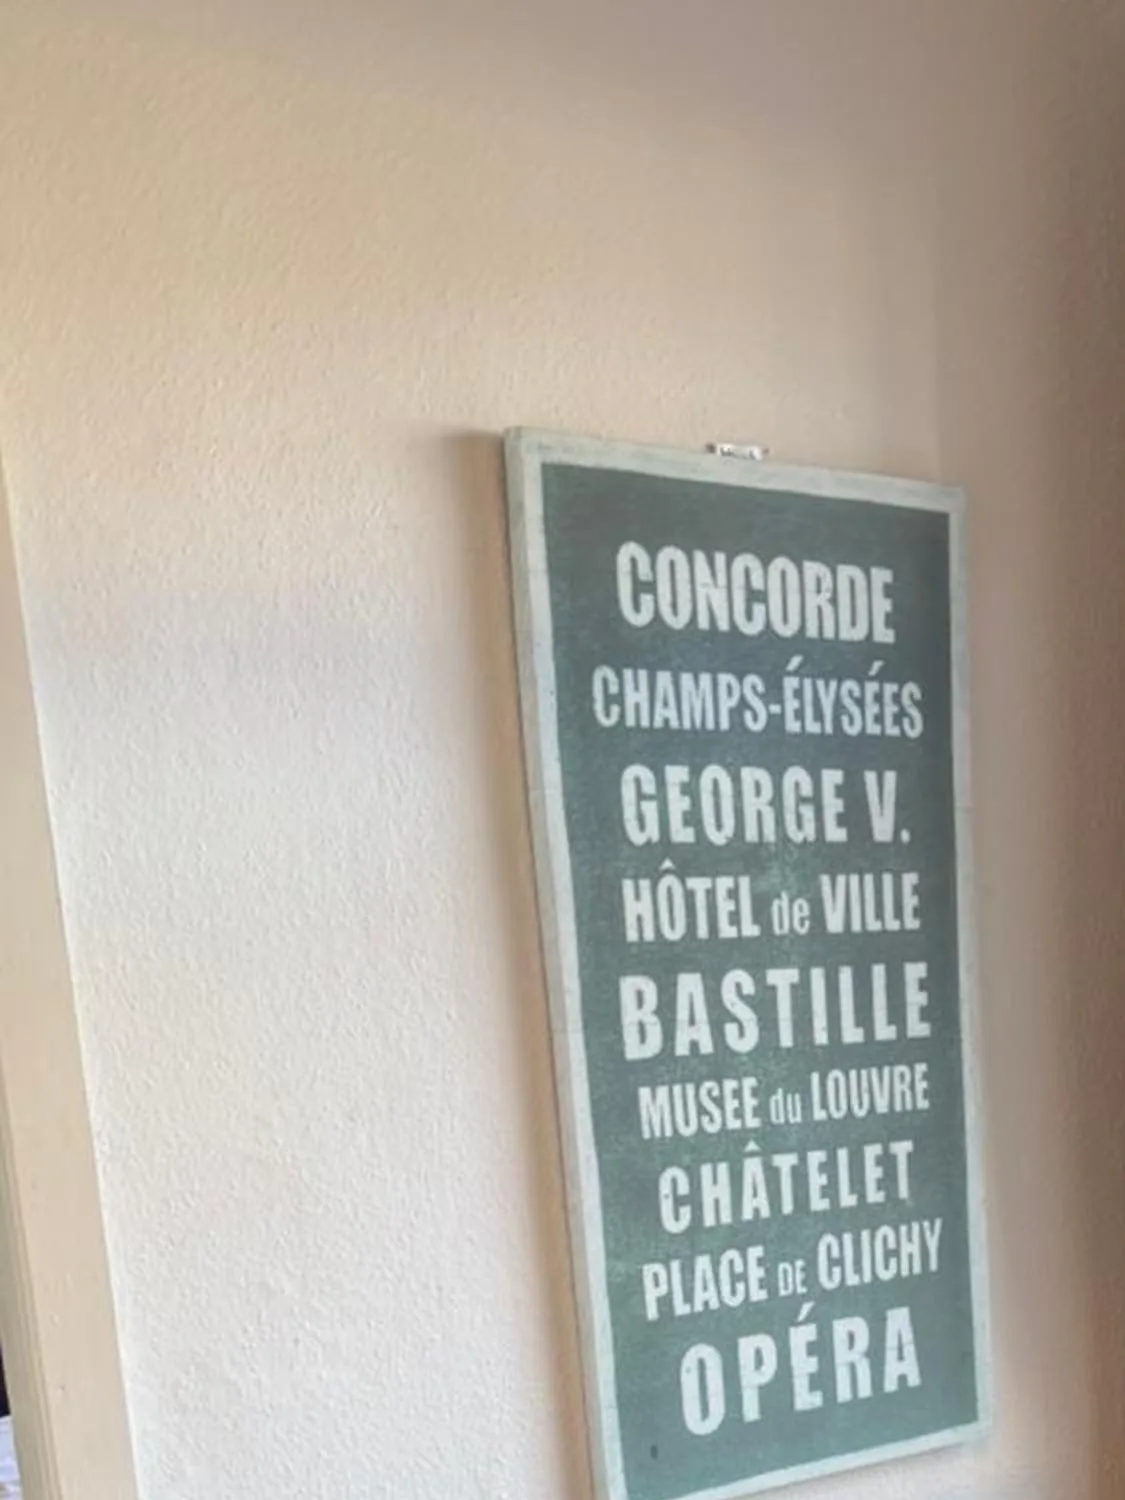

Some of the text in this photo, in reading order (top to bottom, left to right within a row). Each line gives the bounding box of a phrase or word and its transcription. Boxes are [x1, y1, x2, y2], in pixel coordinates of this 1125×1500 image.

[616, 542, 896, 643] CONCORDE
[592, 656, 923, 738] CHAMPS-ÉLYSÉES
[621, 764, 909, 846] GEORGE V.
[622, 859, 921, 942] HÔTEL de VILLE
[619, 962, 931, 1061] BASTILLE
[638, 1063, 930, 1140] MUSEE du LOUVRE
[658, 1139, 914, 1235] CHÂTELET
[642, 1219, 943, 1321] PLACE DE CLICHY
[680, 1303, 922, 1436] OPÉRA
